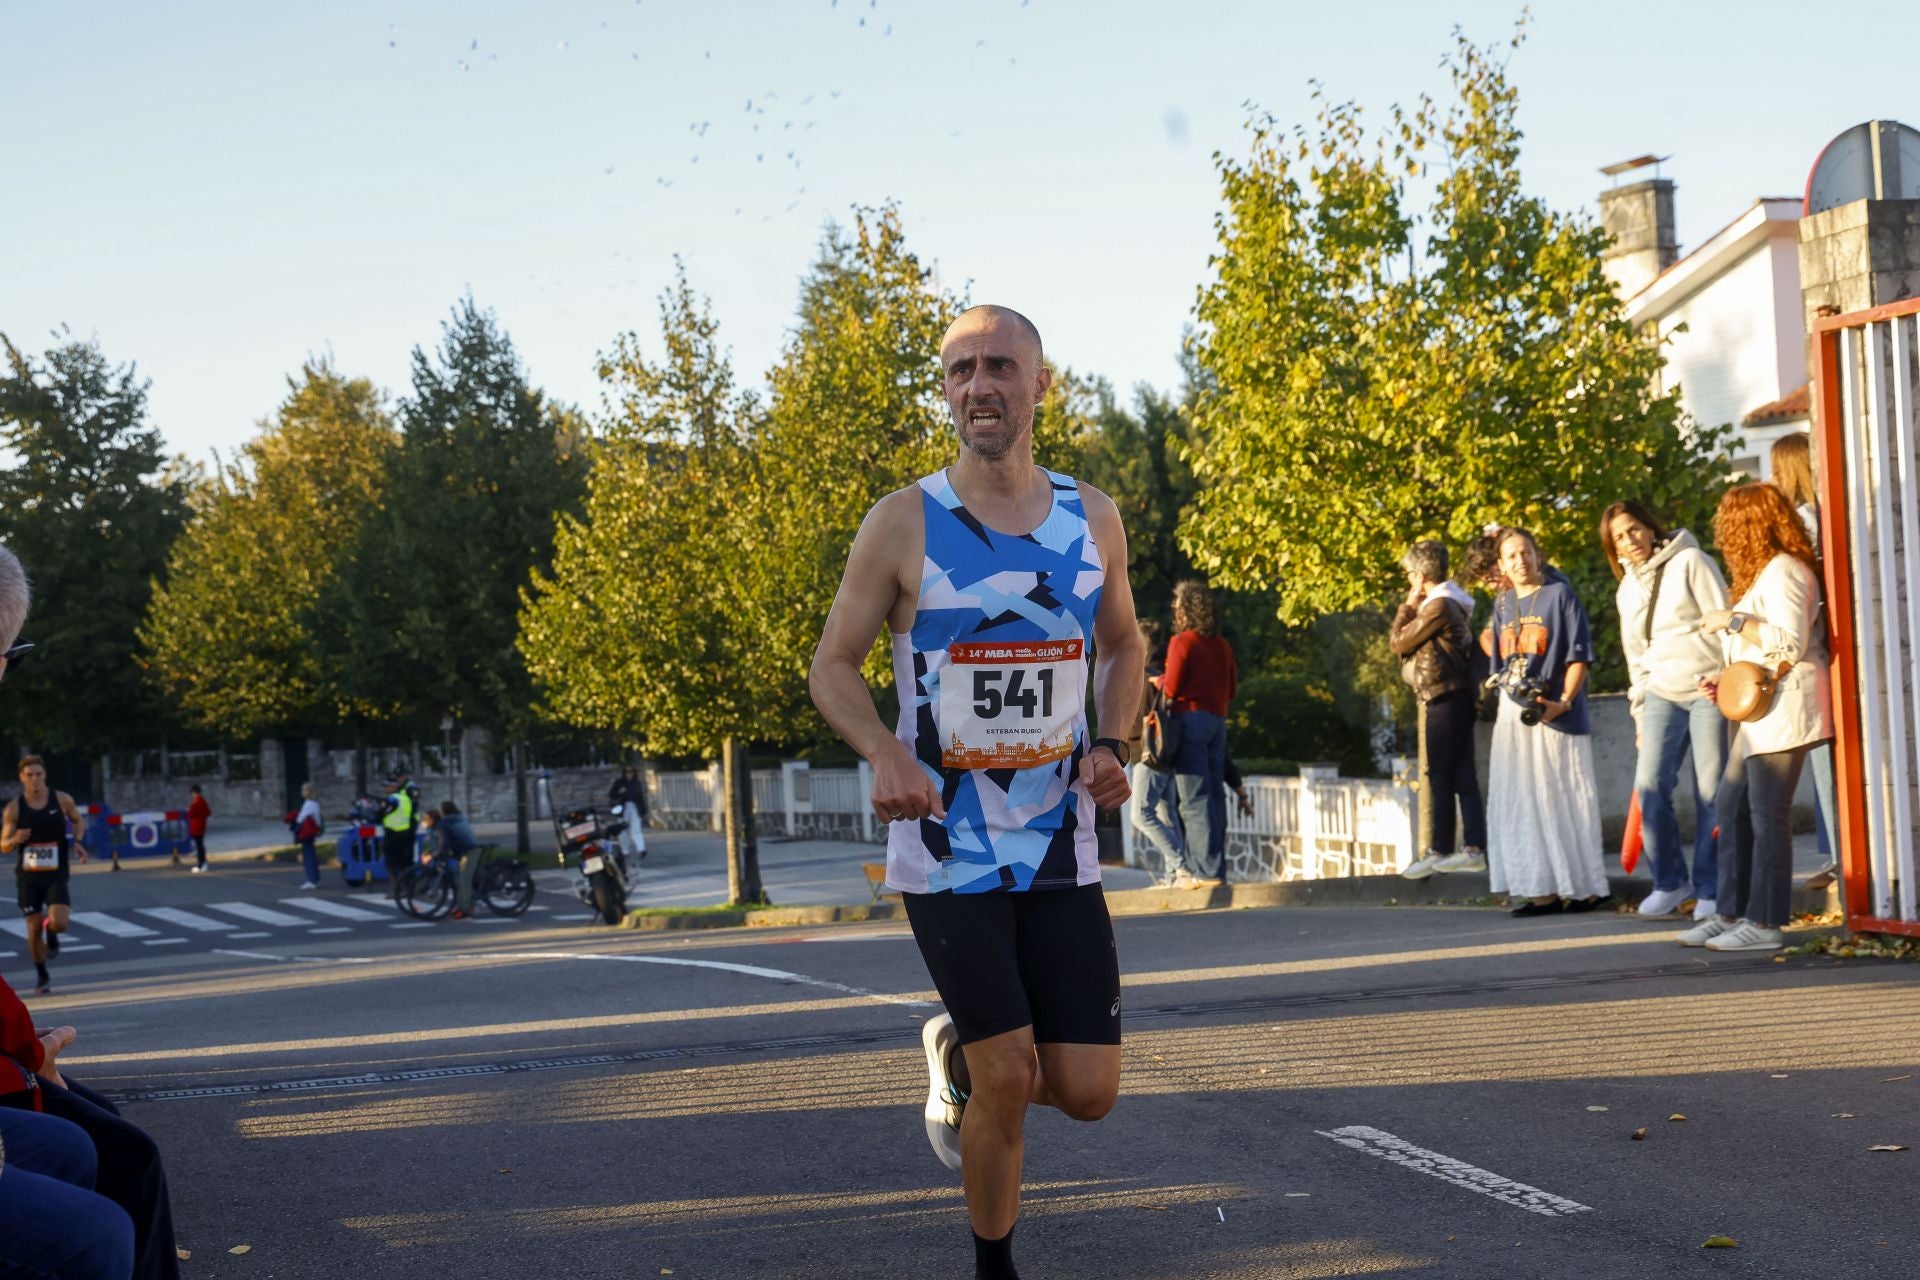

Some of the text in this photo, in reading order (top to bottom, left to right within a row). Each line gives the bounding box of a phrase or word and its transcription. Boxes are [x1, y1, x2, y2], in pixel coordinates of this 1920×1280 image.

[984, 649, 1014, 658] MBA
[1037, 647, 1062, 657] GIJÓN
[973, 669, 1053, 719] 541
